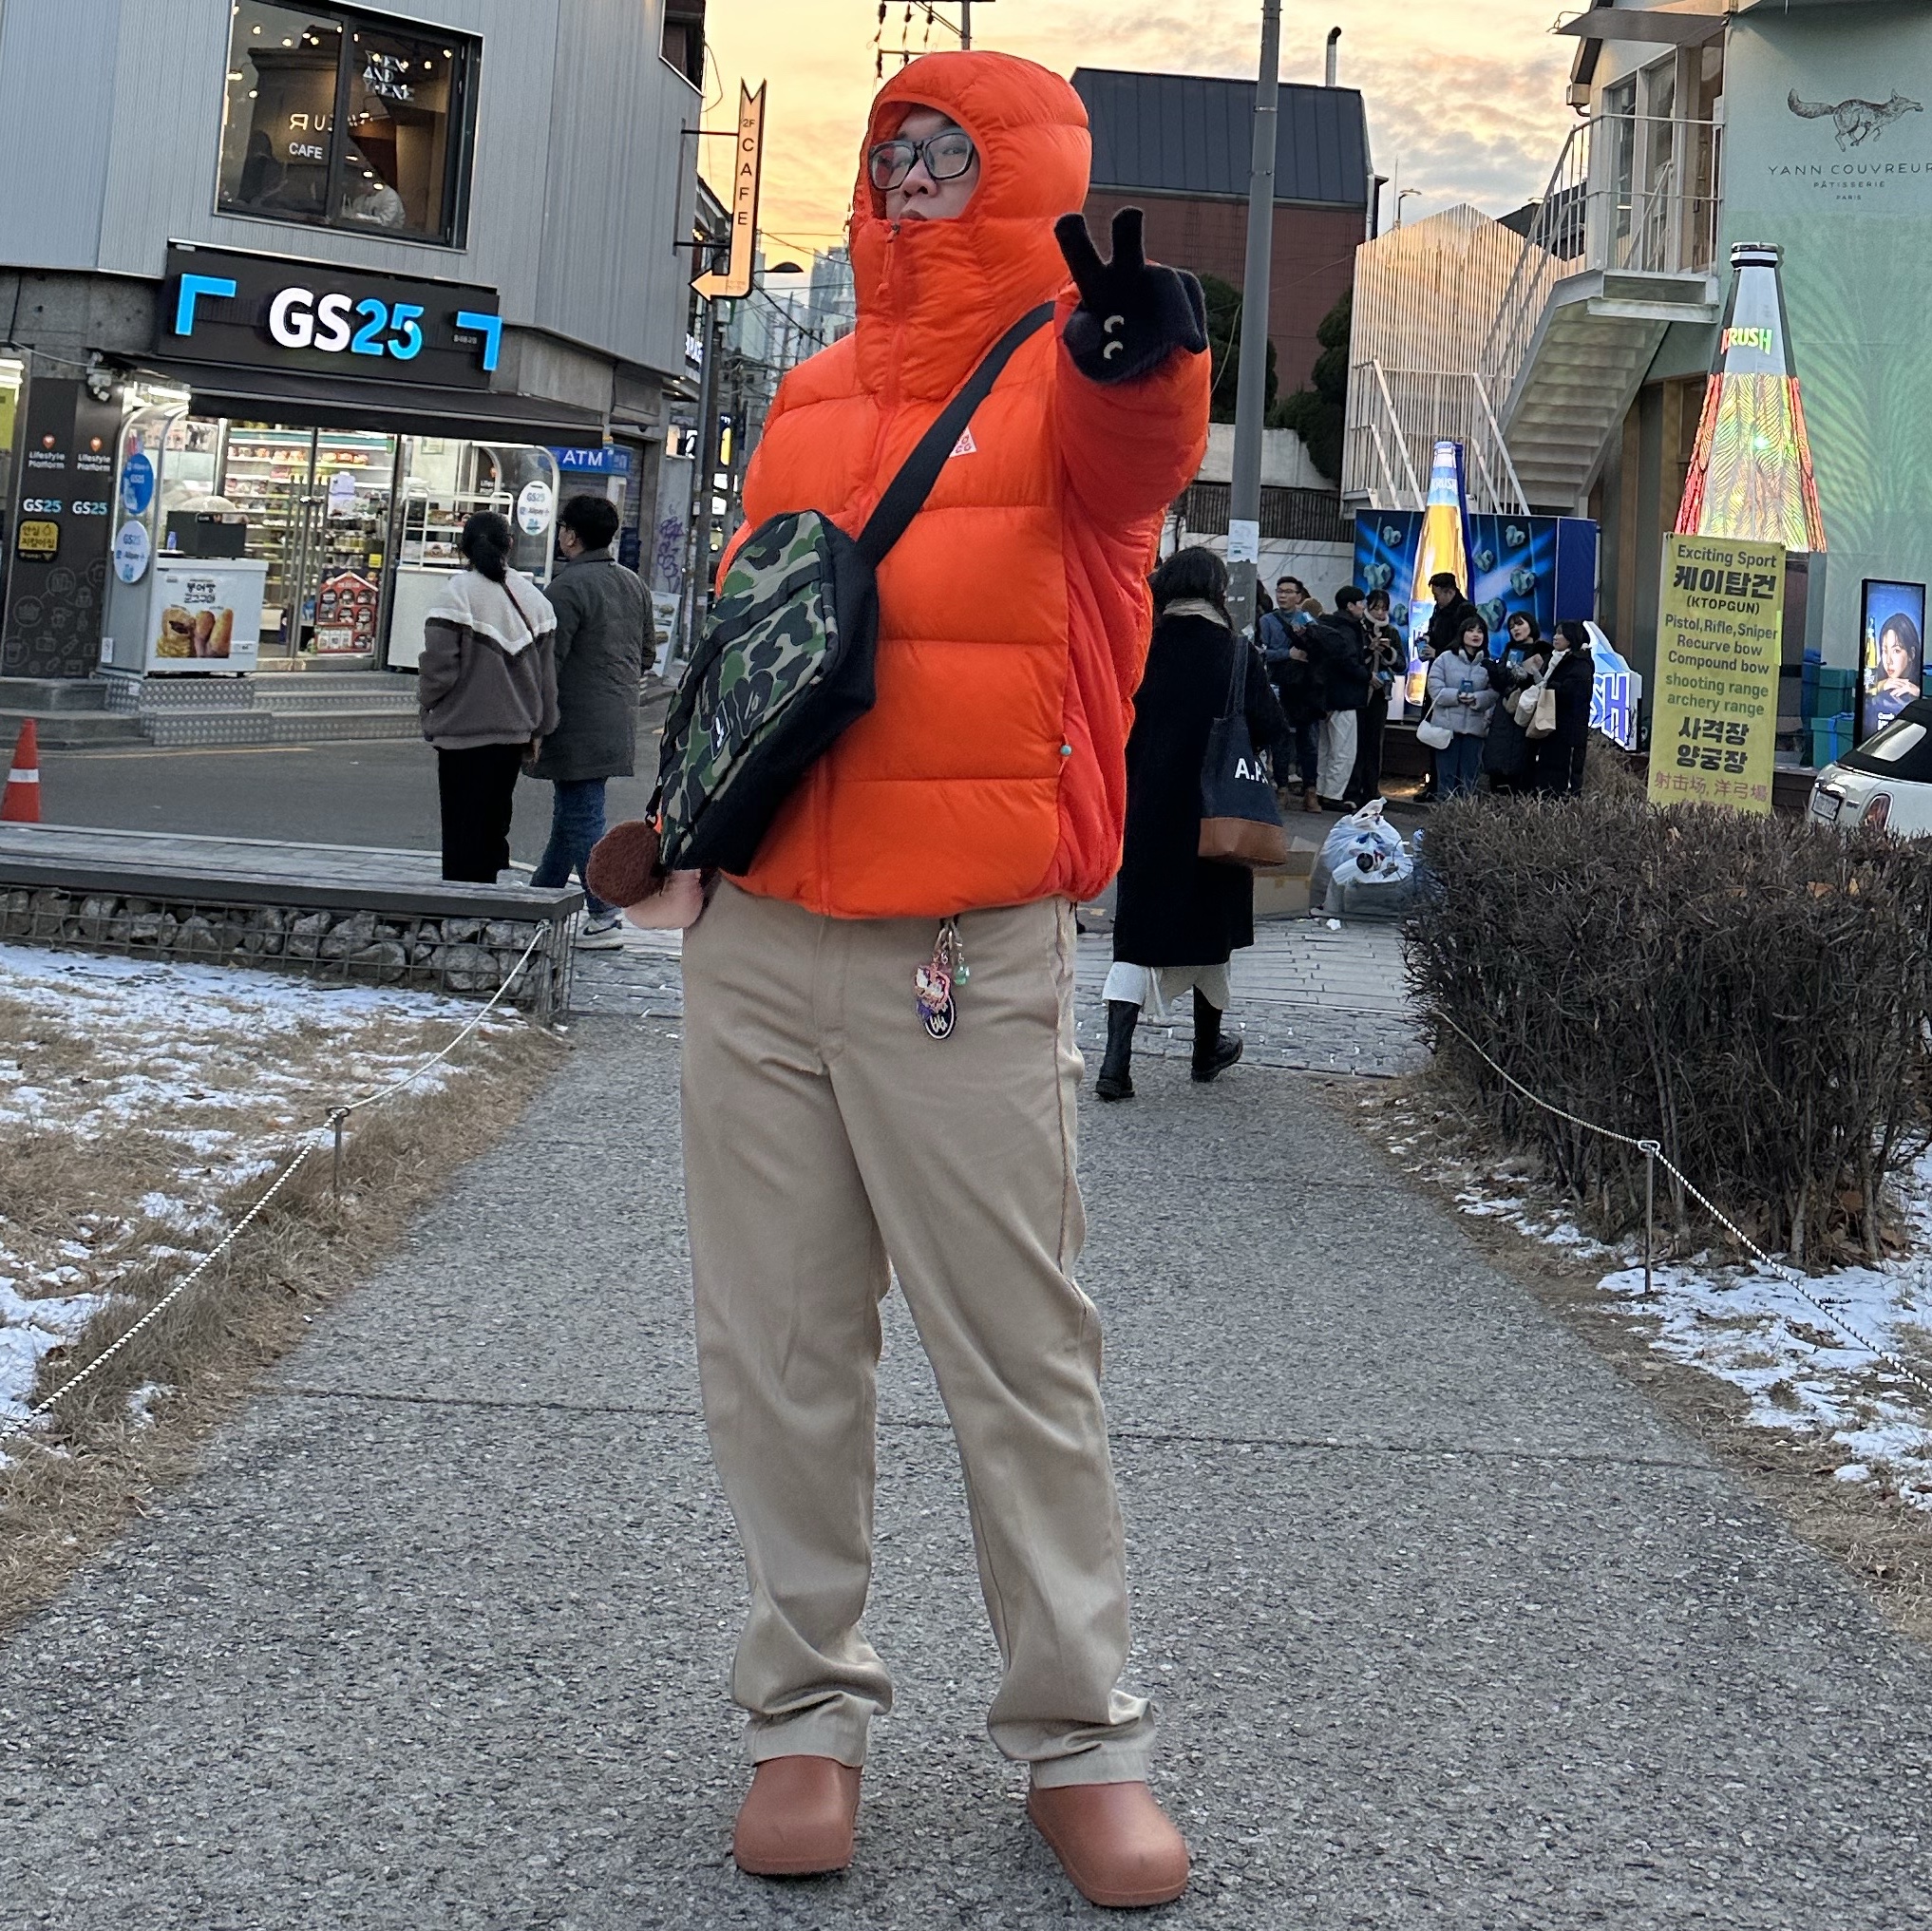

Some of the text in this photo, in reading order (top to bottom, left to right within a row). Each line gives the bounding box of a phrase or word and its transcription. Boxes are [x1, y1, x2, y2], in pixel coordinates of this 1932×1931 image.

[742, 118, 756, 128] 2F
[288, 142, 324, 160] CAFE
[737, 137, 755, 226] CAFE
[1768, 164, 1823, 176] YANN
[268, 287, 426, 361] GS25
[562, 449, 603, 467] ATM
[23, 498, 63, 514] GS25
[72, 501, 108, 516] GS25
[1677, 544, 1777, 569] Exciting Sport
[1673, 564, 1777, 599] 케이탑건
[1686, 594, 1760, 616] (KTOPGUN)
[1676, 634, 1763, 656] Recurve bow
[1668, 650, 1770, 674] Compound bow
[1665, 672, 1770, 699] shooting range
[1667, 692, 1765, 718] archery range
[1677, 716, 1750, 746] 사격장
[1676, 744, 1748, 774] 양궁장
